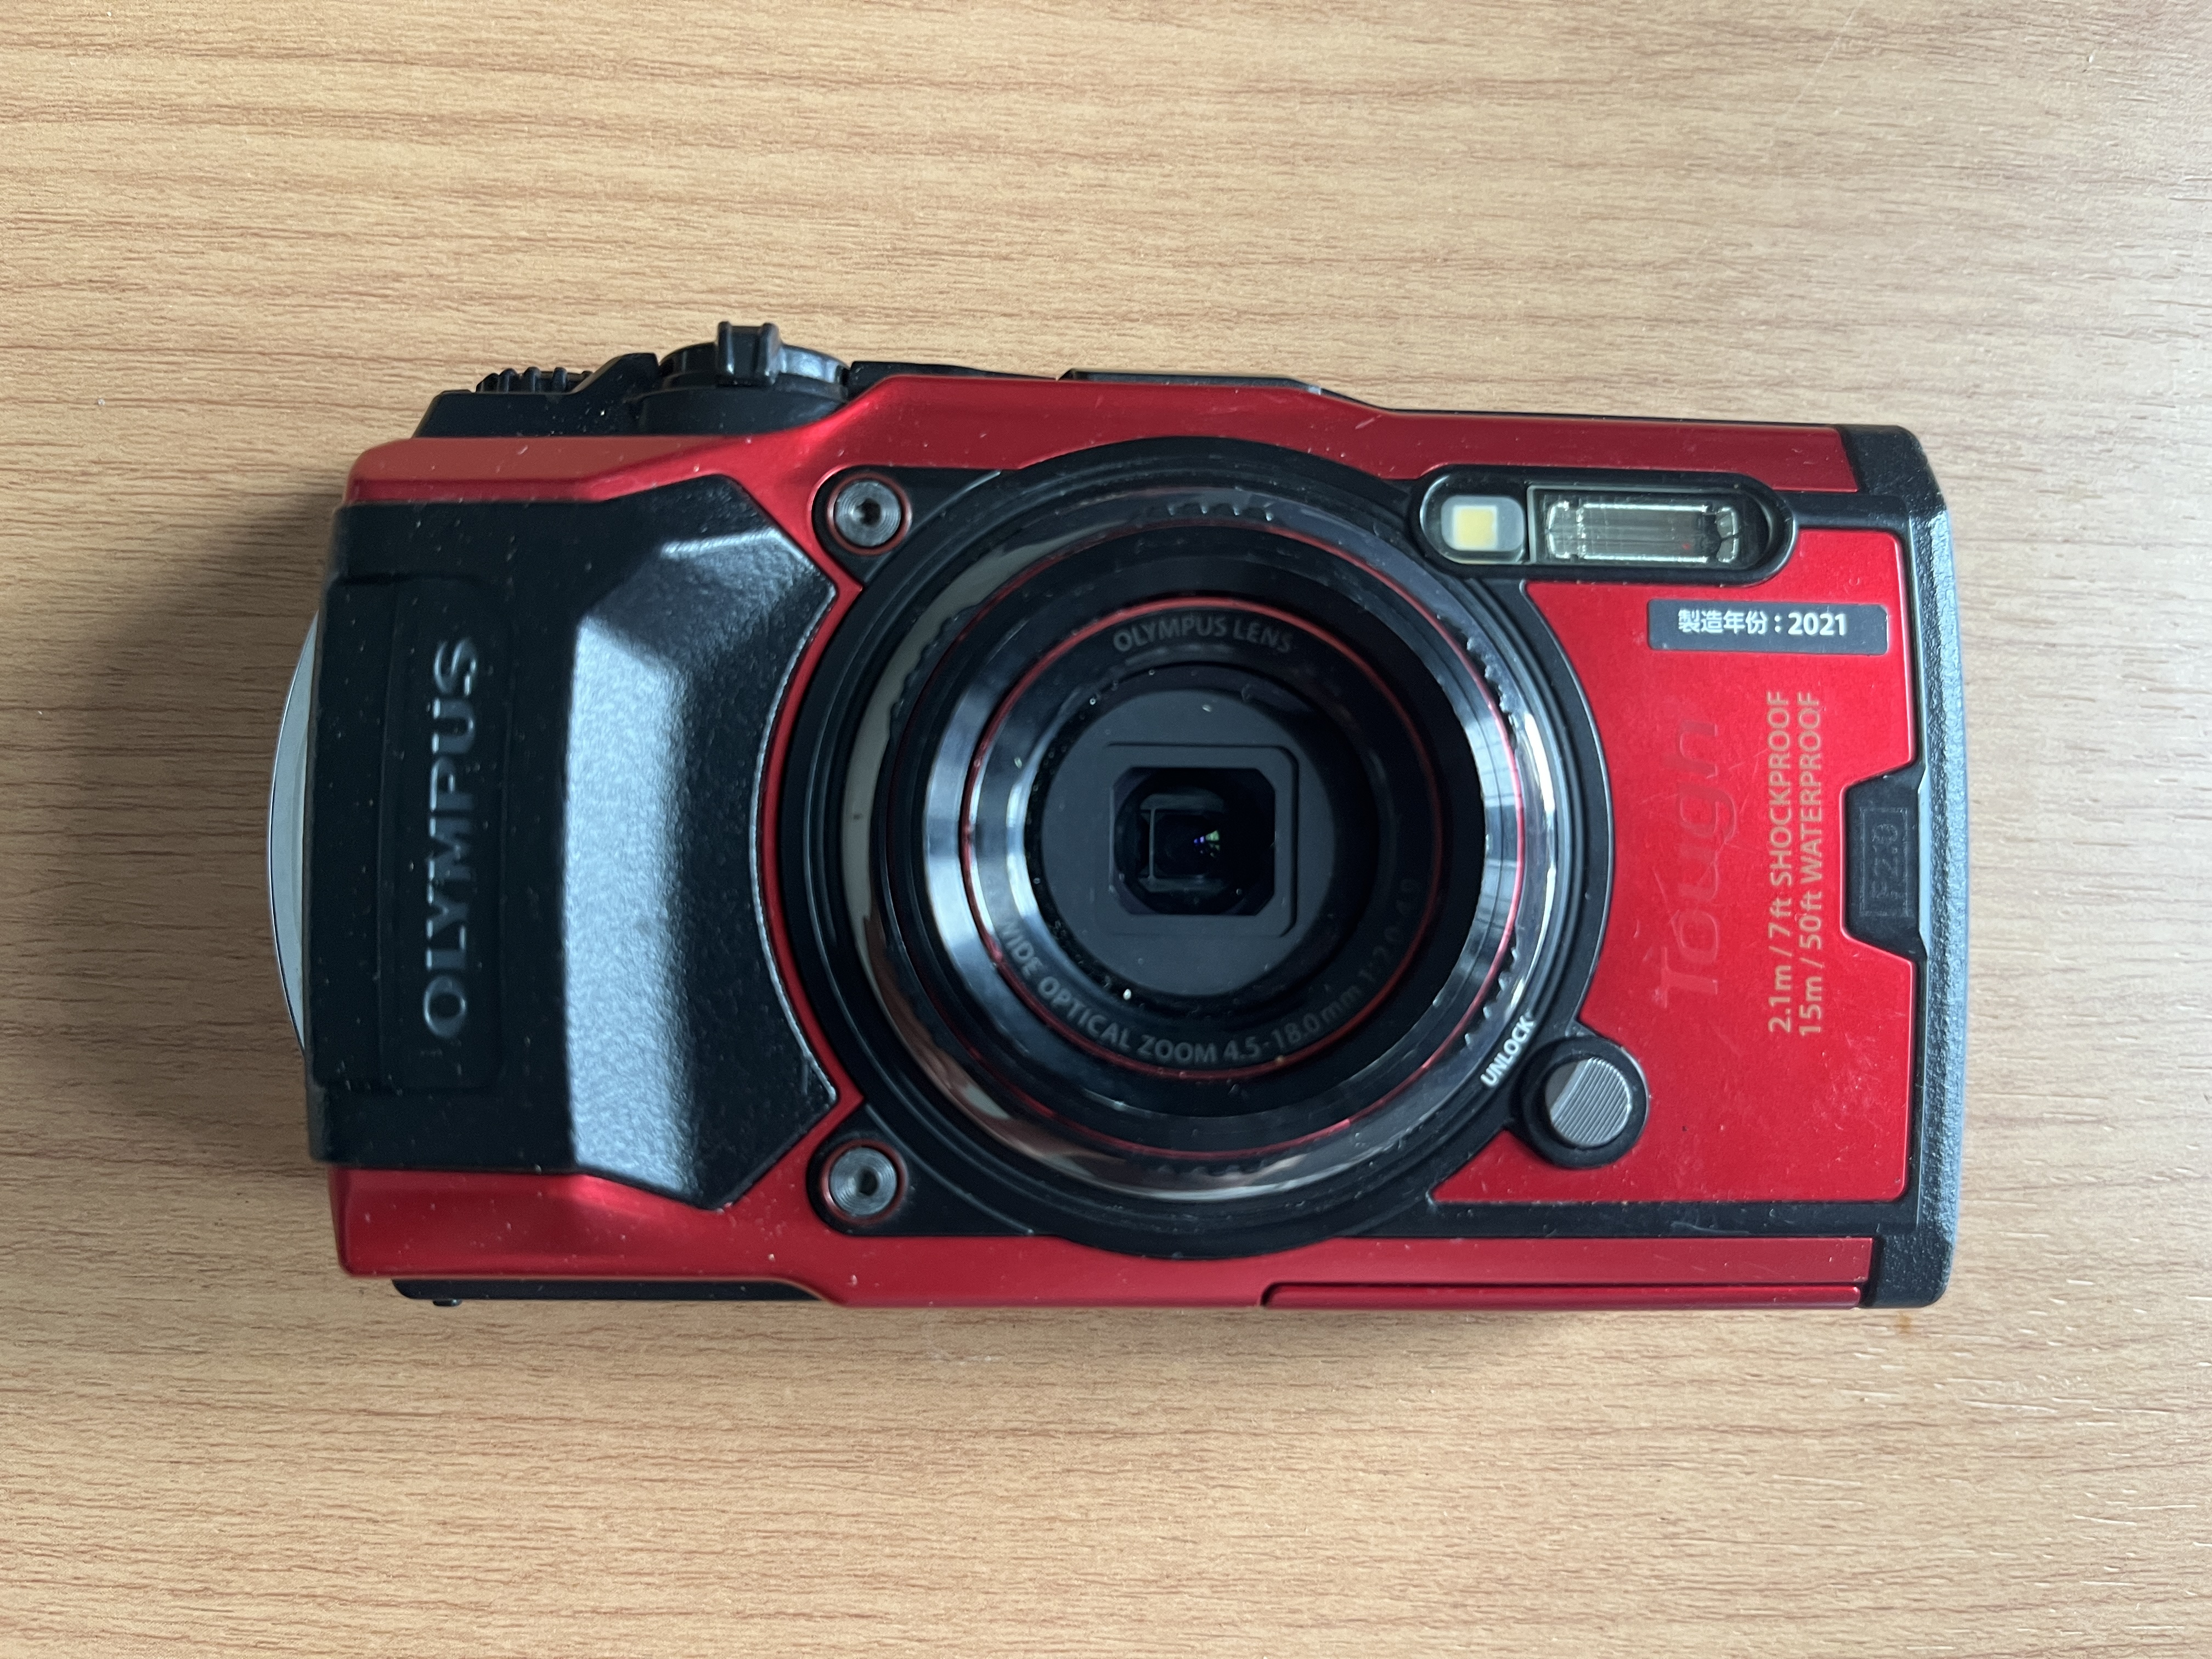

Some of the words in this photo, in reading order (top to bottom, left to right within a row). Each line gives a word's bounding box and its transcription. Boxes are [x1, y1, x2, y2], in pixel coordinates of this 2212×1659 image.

[1113, 614, 1227, 652] OLYMPUS
[1233, 619, 1293, 653] LENS
[1766, 691, 1792, 887] SHOCKPROOF
[1797, 691, 1822, 883] WATERPROOF
[422, 636, 479, 1039] OLYMPUS
[1037, 977, 1131, 1051] OPTICAL
[1138, 1034, 1217, 1063] ZOOM
[1768, 964, 1792, 1034] 2.1m
[1798, 975, 1822, 1037] 15m
[1480, 1014, 1535, 1087] UNLOCK
